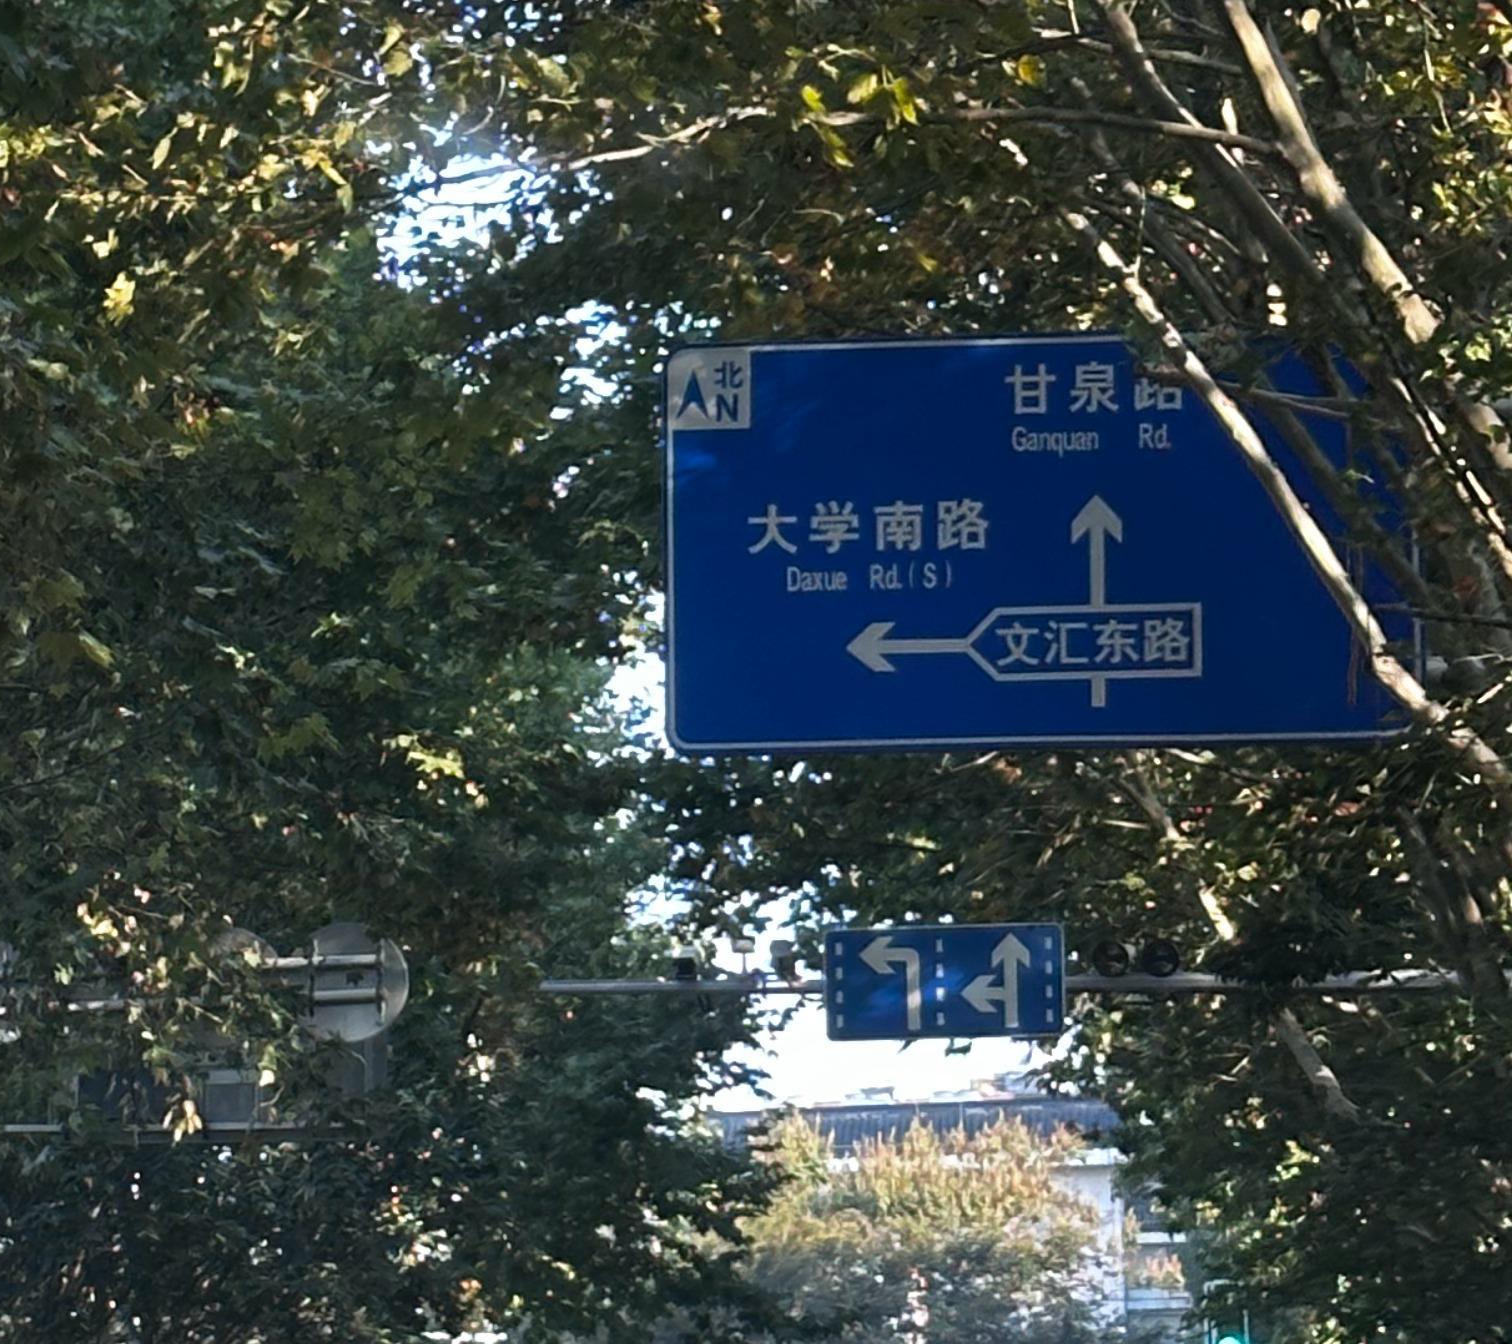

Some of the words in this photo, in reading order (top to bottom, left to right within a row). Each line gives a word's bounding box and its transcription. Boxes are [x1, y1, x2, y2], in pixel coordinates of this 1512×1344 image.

[714, 361, 744, 389] 北
[716, 394, 738, 422] N
[1011, 426, 1099, 457] Ganquan
[747, 498, 989, 554] 大学南路
[787, 565, 848, 592] Daxue
[995, 617, 1190, 666] 文汇东路
